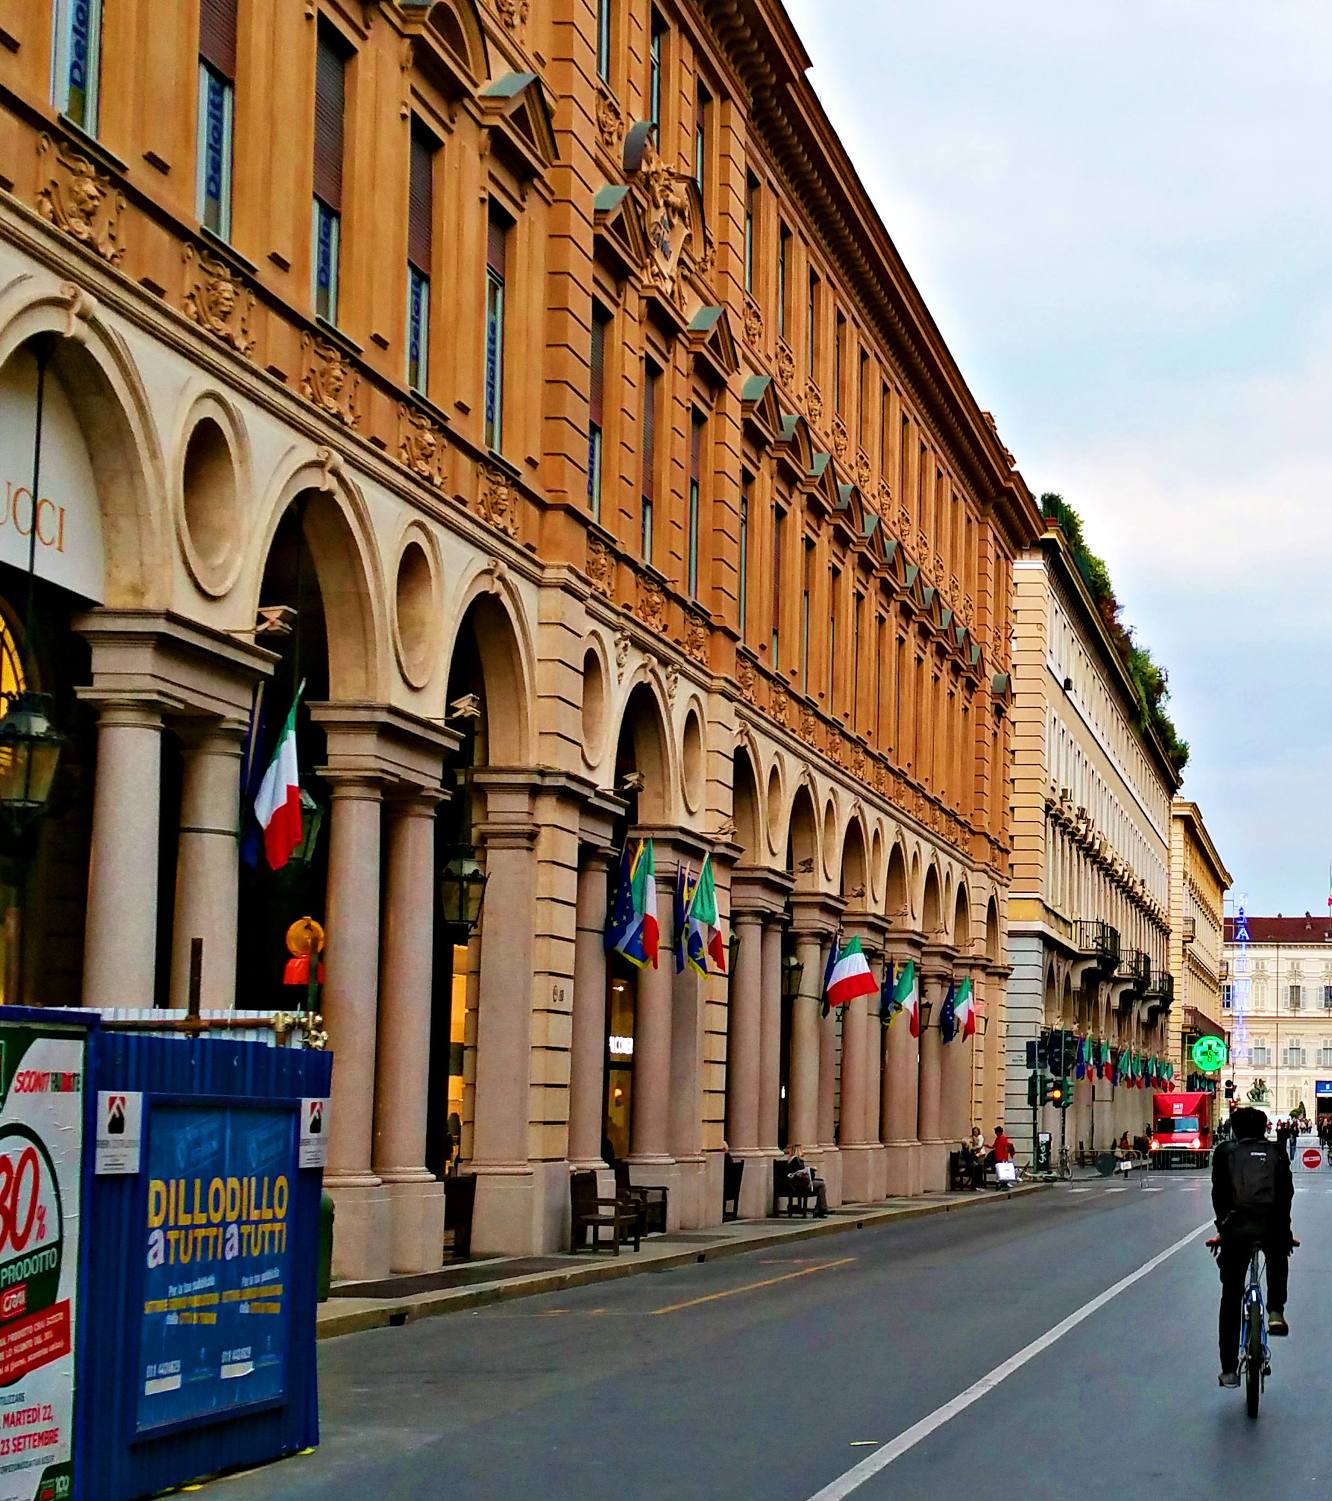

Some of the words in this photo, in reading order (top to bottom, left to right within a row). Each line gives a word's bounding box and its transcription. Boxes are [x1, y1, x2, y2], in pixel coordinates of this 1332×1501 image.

[146, 1228, 165, 1269] a
[166, 1226, 223, 1265] TUTTI
[225, 1223, 239, 1261] a
[240, 1222, 287, 1258] TUTTI
[0, 1247, 57, 1288] PRODOTTO
[2, 1403, 41, 1429] MARTEDÌ
[12, 1427, 60, 1455] SETTEMBRE
